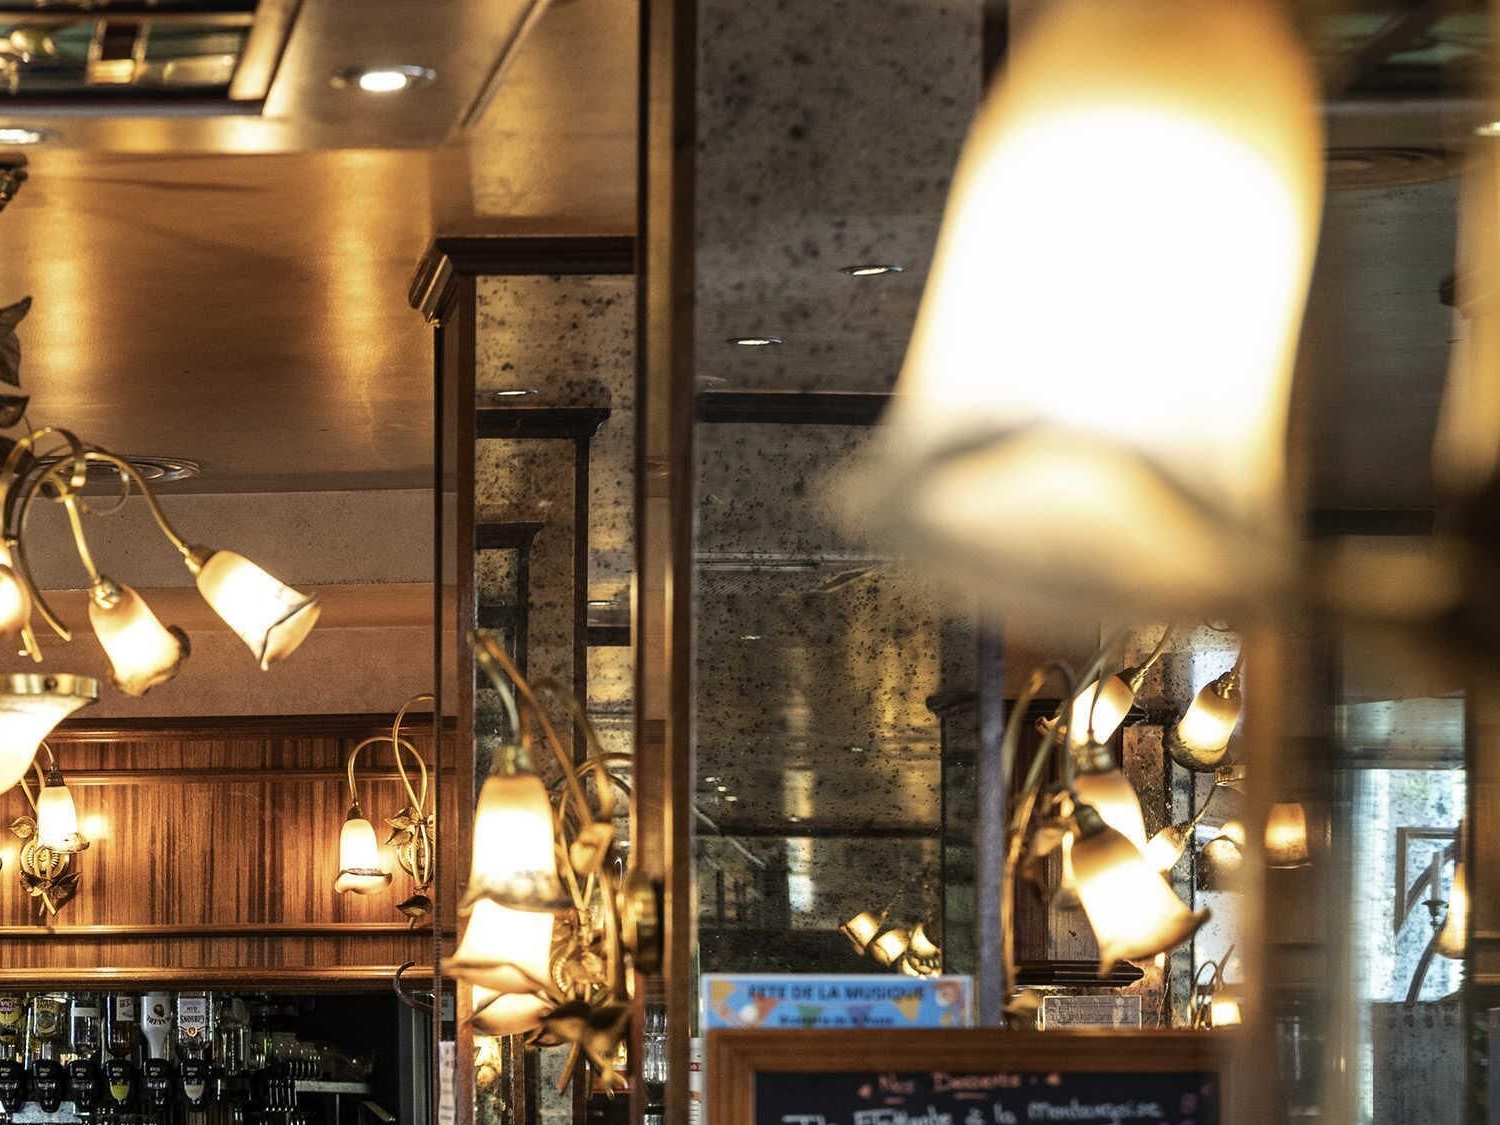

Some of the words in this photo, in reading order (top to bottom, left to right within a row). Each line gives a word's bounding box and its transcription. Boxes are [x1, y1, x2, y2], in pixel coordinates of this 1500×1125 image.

[791, 985, 812, 999] DE
[818, 985, 838, 998] LA
[846, 985, 924, 998] MUSIQUE
[878, 1073, 916, 1095] Nos
[993, 1102, 1017, 1125] la
